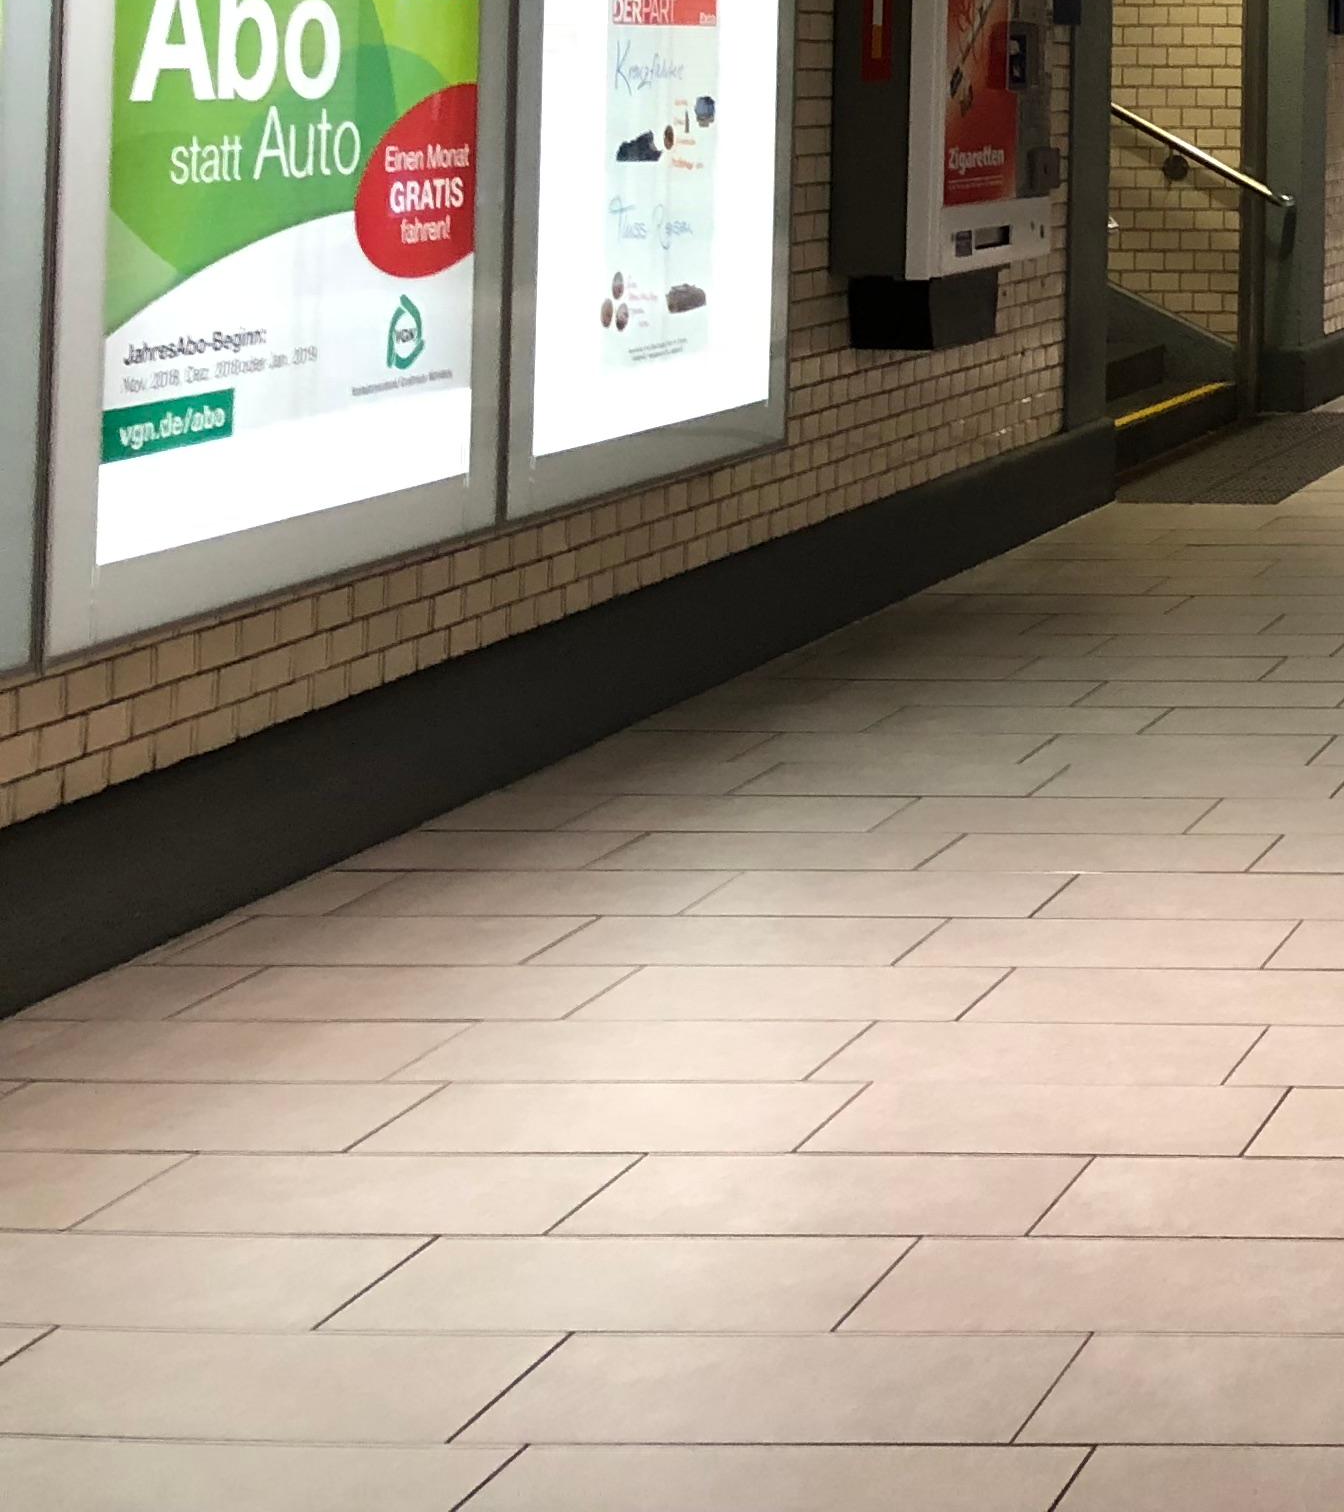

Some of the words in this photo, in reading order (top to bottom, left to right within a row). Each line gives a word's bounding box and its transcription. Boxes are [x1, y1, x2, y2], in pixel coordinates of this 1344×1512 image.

[170, 136, 242, 185] statt
[253, 106, 361, 180] Auto
[385, 144, 424, 173] Einen
[426, 143, 470, 170] Monat
[948, 145, 1006, 176] Zigaretten
[389, 176, 464, 214] GRATIS
[400, 214, 451, 245] fahren!
[123, 327, 267, 365] JahresAbo-Beginn:
[119, 405, 226, 450] vgn.de/abo
